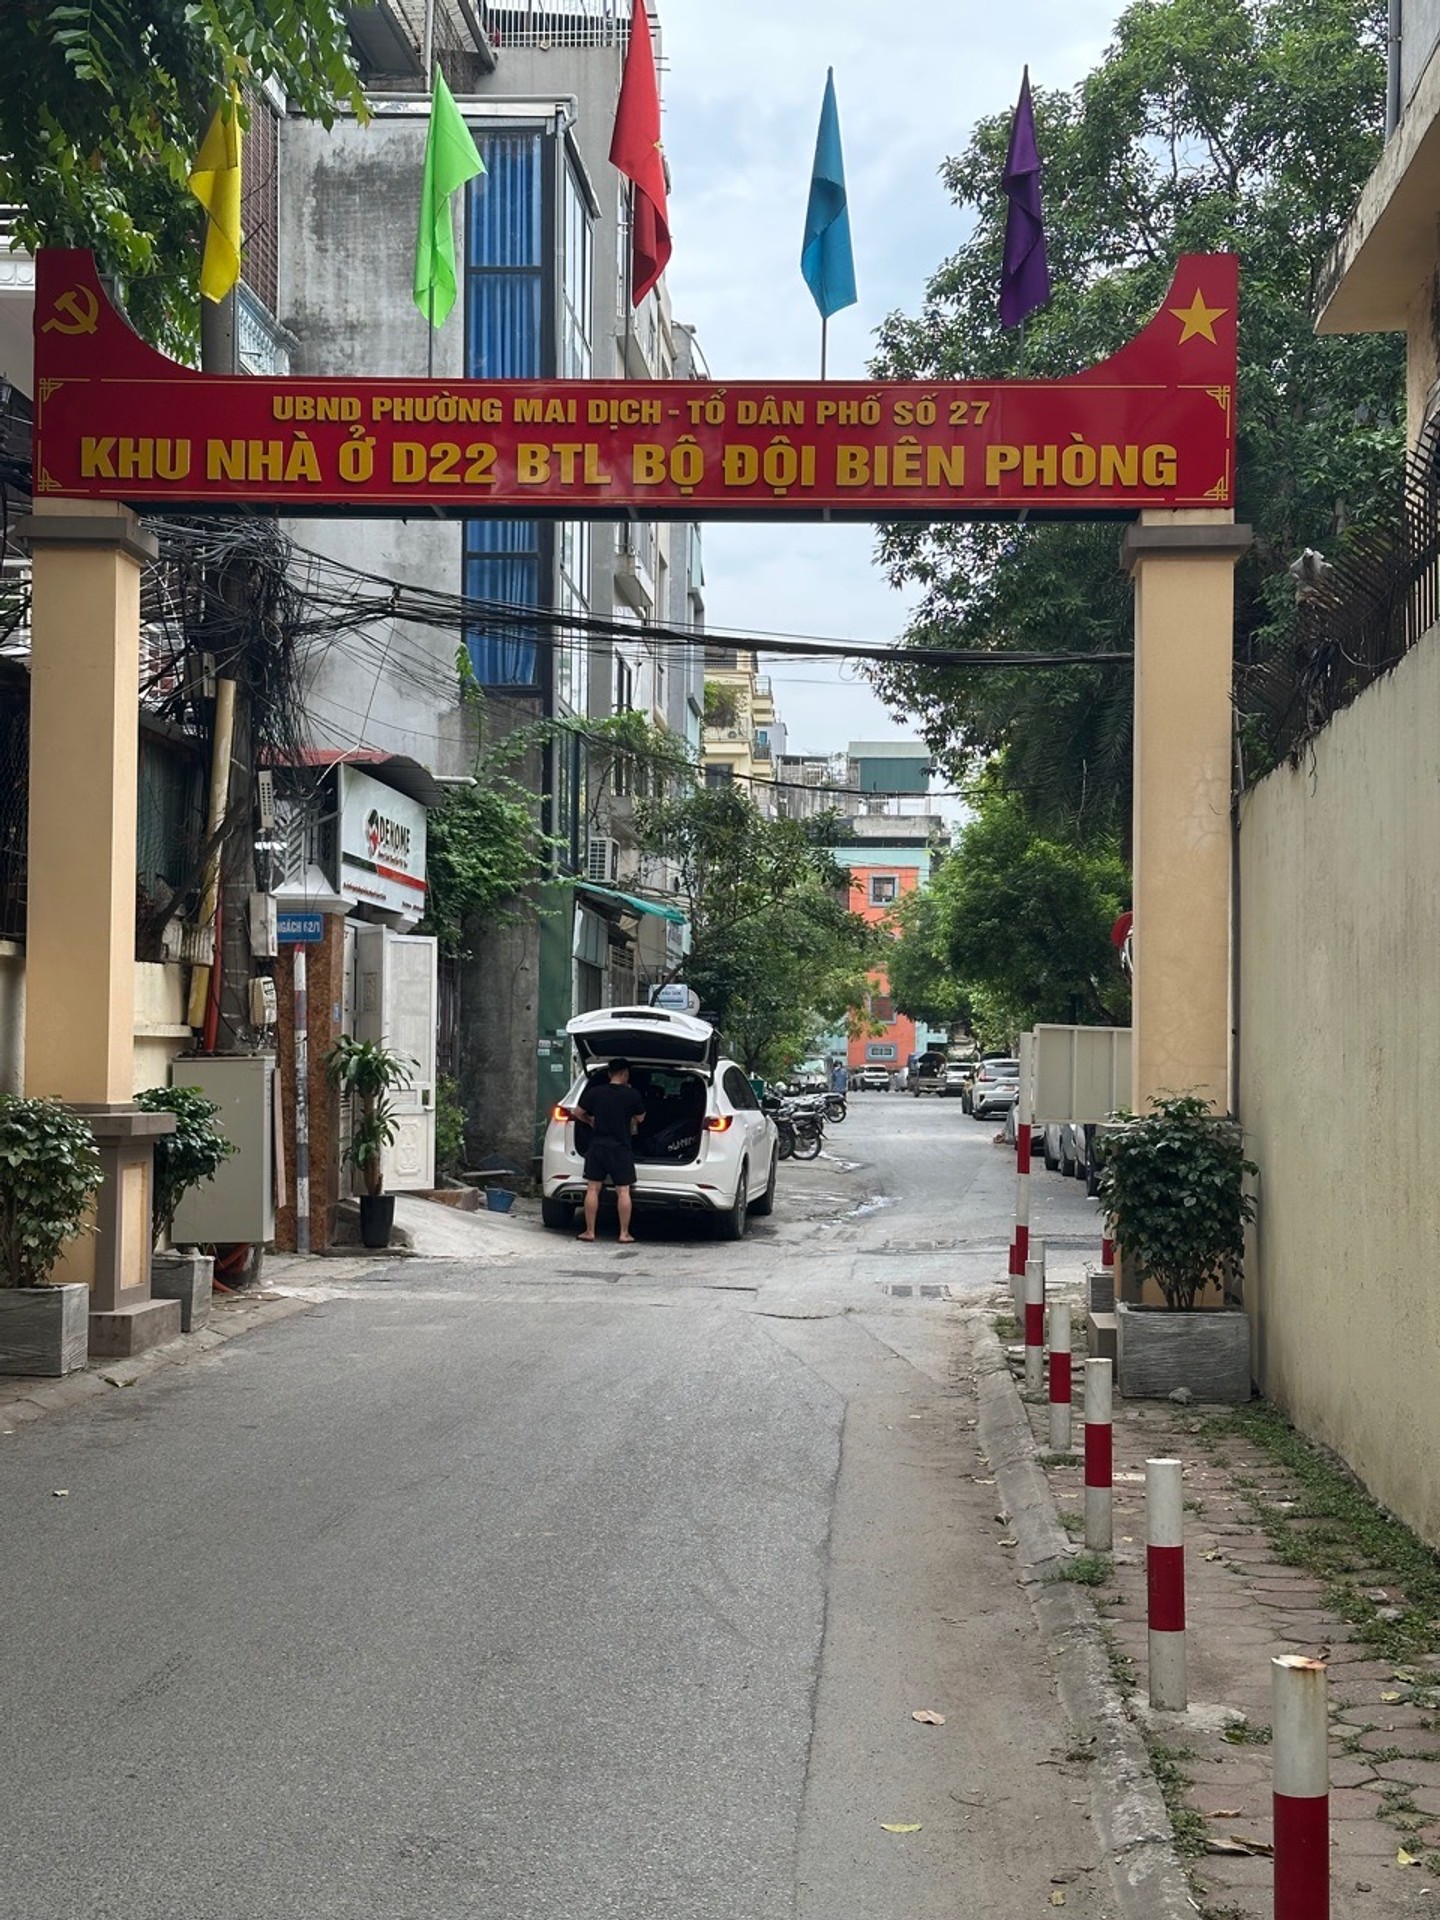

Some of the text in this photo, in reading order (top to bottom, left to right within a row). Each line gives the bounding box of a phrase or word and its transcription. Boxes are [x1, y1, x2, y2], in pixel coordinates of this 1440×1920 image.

[273, 396, 361, 422] UBND
[372, 390, 502, 423] PHƯỜNG
[514, 399, 577, 424] MAI
[588, 399, 661, 430] DỊCH
[687, 388, 727, 425] TỔ
[737, 395, 805, 426] DÂN
[817, 392, 882, 426] PHỐ
[893, 392, 939, 426] SỐ
[948, 401, 990, 426] 27
[81, 425, 1178, 496] KHU NHÀ Ở D22 BTL BỘ ĐỘI BIÊN PHÒNG
